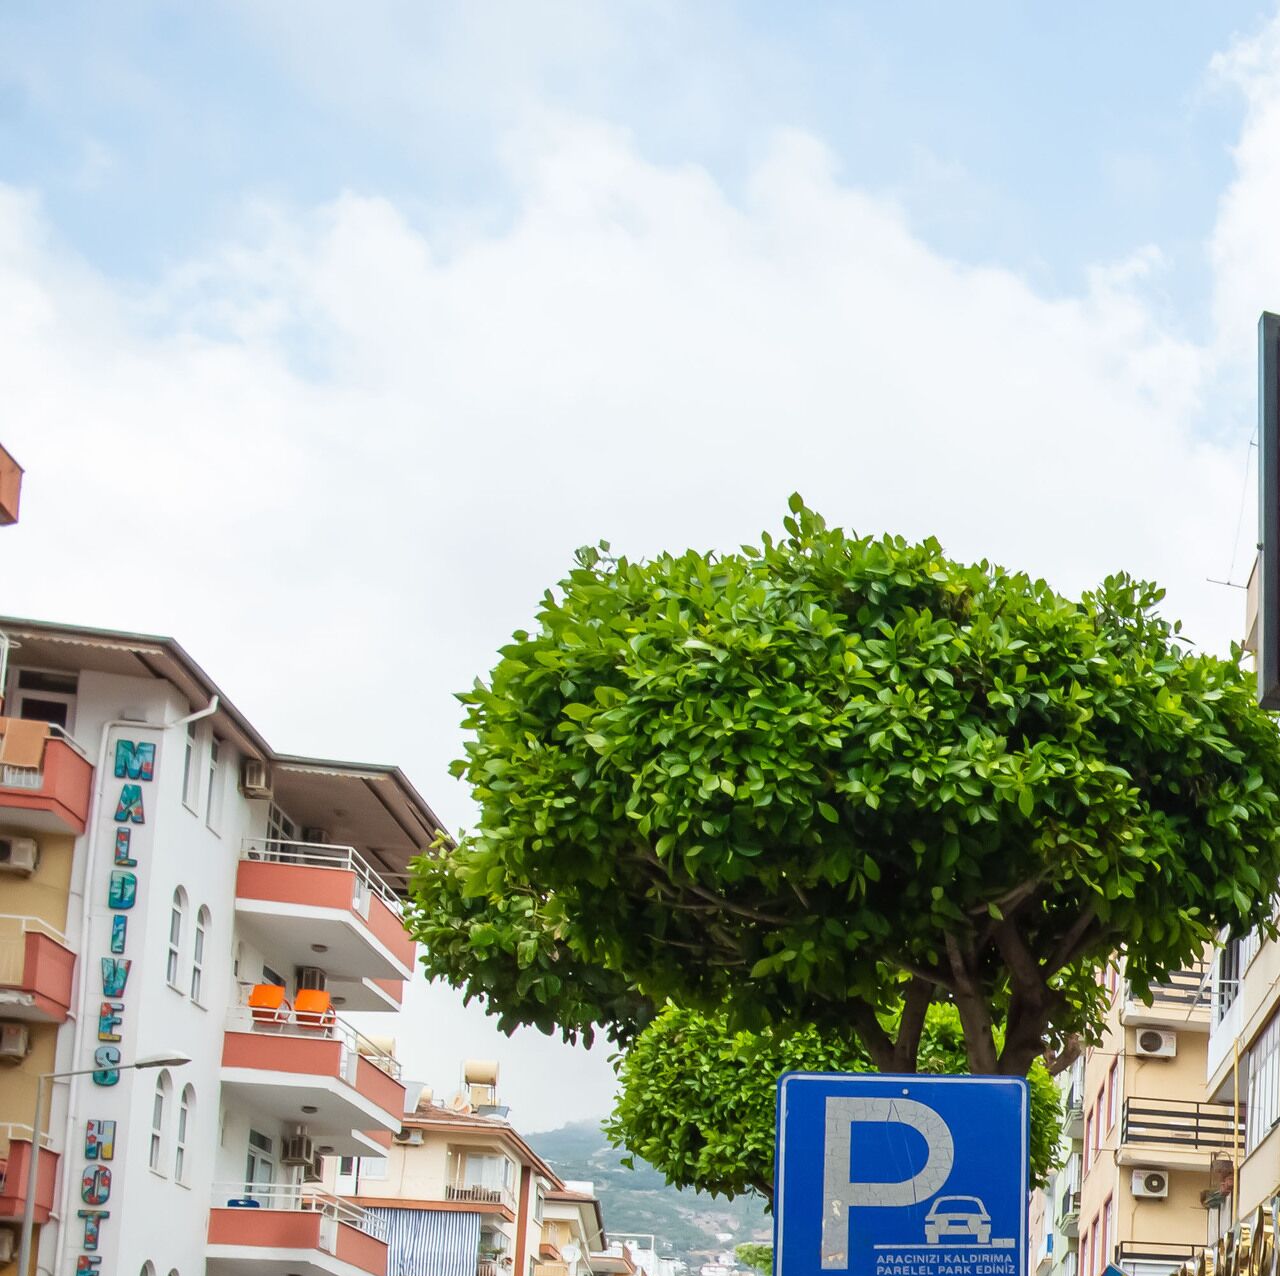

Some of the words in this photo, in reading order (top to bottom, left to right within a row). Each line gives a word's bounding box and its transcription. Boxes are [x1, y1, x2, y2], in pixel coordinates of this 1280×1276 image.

[92, 739, 157, 1087] MALDIVES
[820, 1096, 954, 1270] P
[876, 1265, 934, 1276] PARELEL
[938, 1264, 972, 1274] PARK
